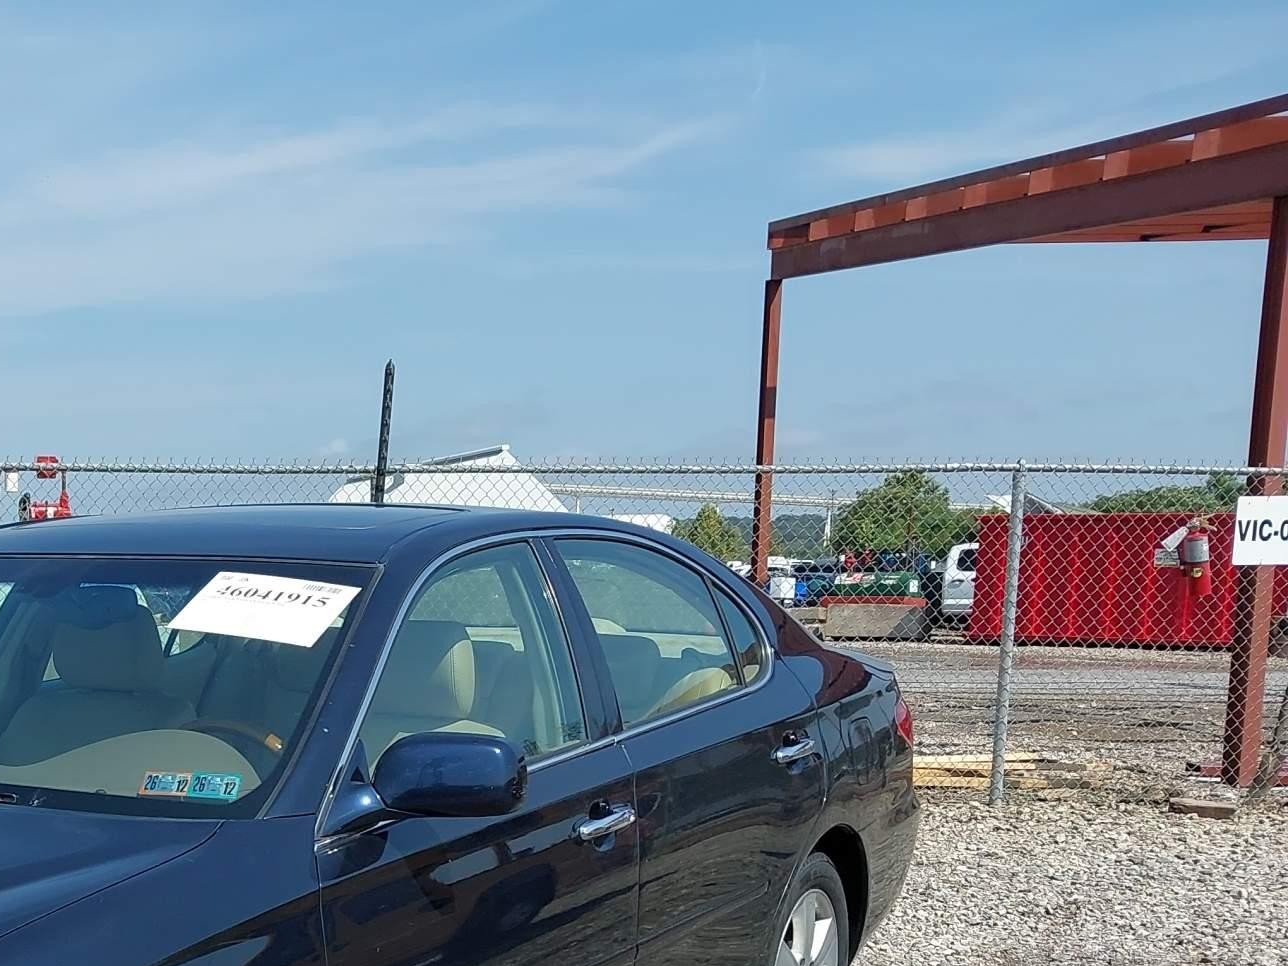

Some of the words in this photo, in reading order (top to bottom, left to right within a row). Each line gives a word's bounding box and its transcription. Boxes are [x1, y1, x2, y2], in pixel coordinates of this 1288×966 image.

[215, 584, 332, 608] 46041915
[143, 774, 159, 791] 26
[174, 778, 189, 793] 12
[192, 776, 207, 793] 26
[221, 781, 237, 796] 12
